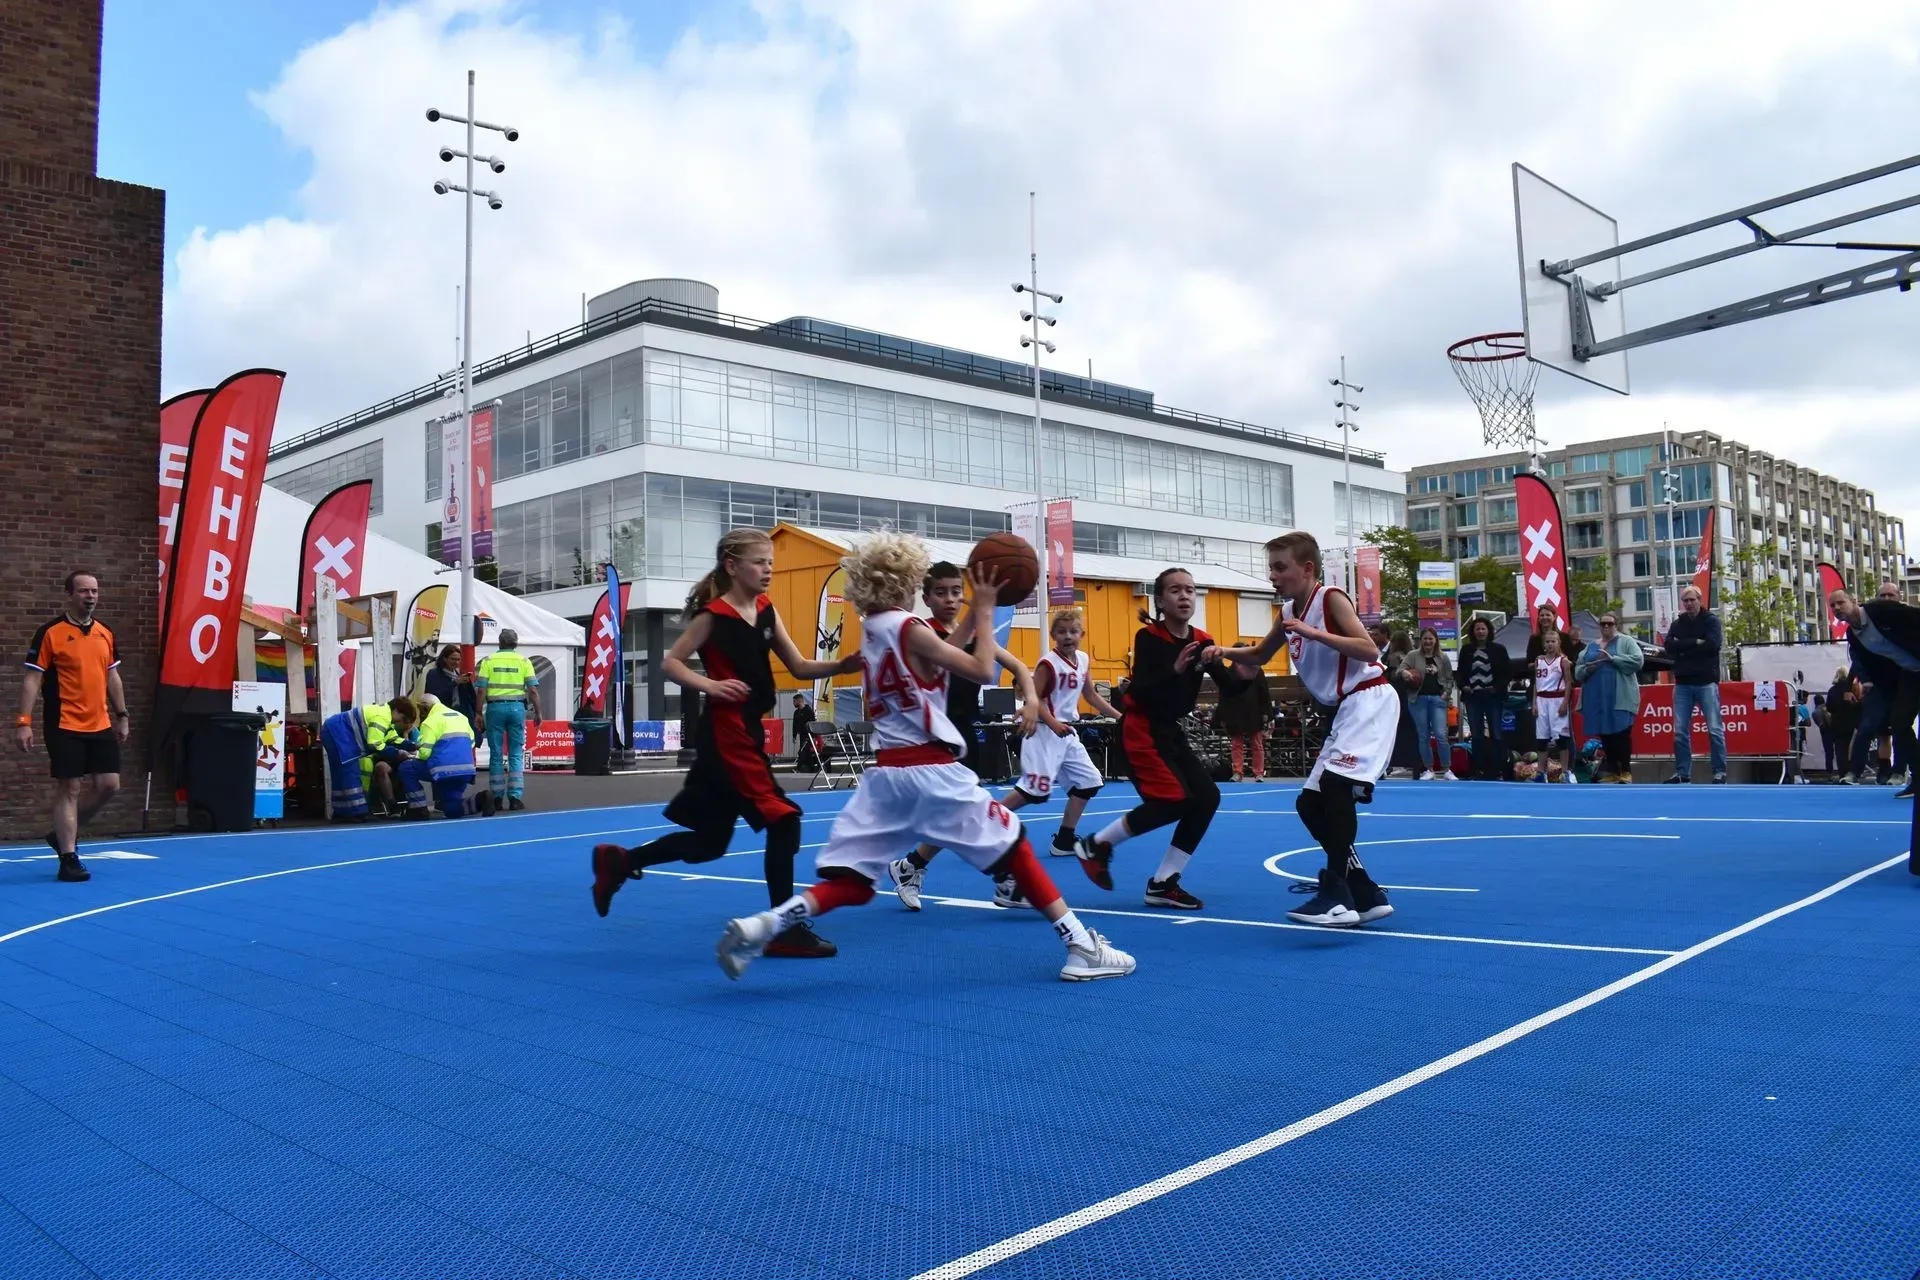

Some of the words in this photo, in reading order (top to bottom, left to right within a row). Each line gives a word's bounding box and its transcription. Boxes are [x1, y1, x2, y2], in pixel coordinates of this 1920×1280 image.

[190, 426, 249, 664] EHBO
[1058, 673, 1078, 690] 76
[1643, 702, 1747, 717] Ameam
[1643, 722, 1676, 737] spo
[1692, 721, 1747, 733] saen
[536, 739, 557, 748] sport
[1026, 774, 1050, 792] 76
[989, 800, 1010, 830] 2
